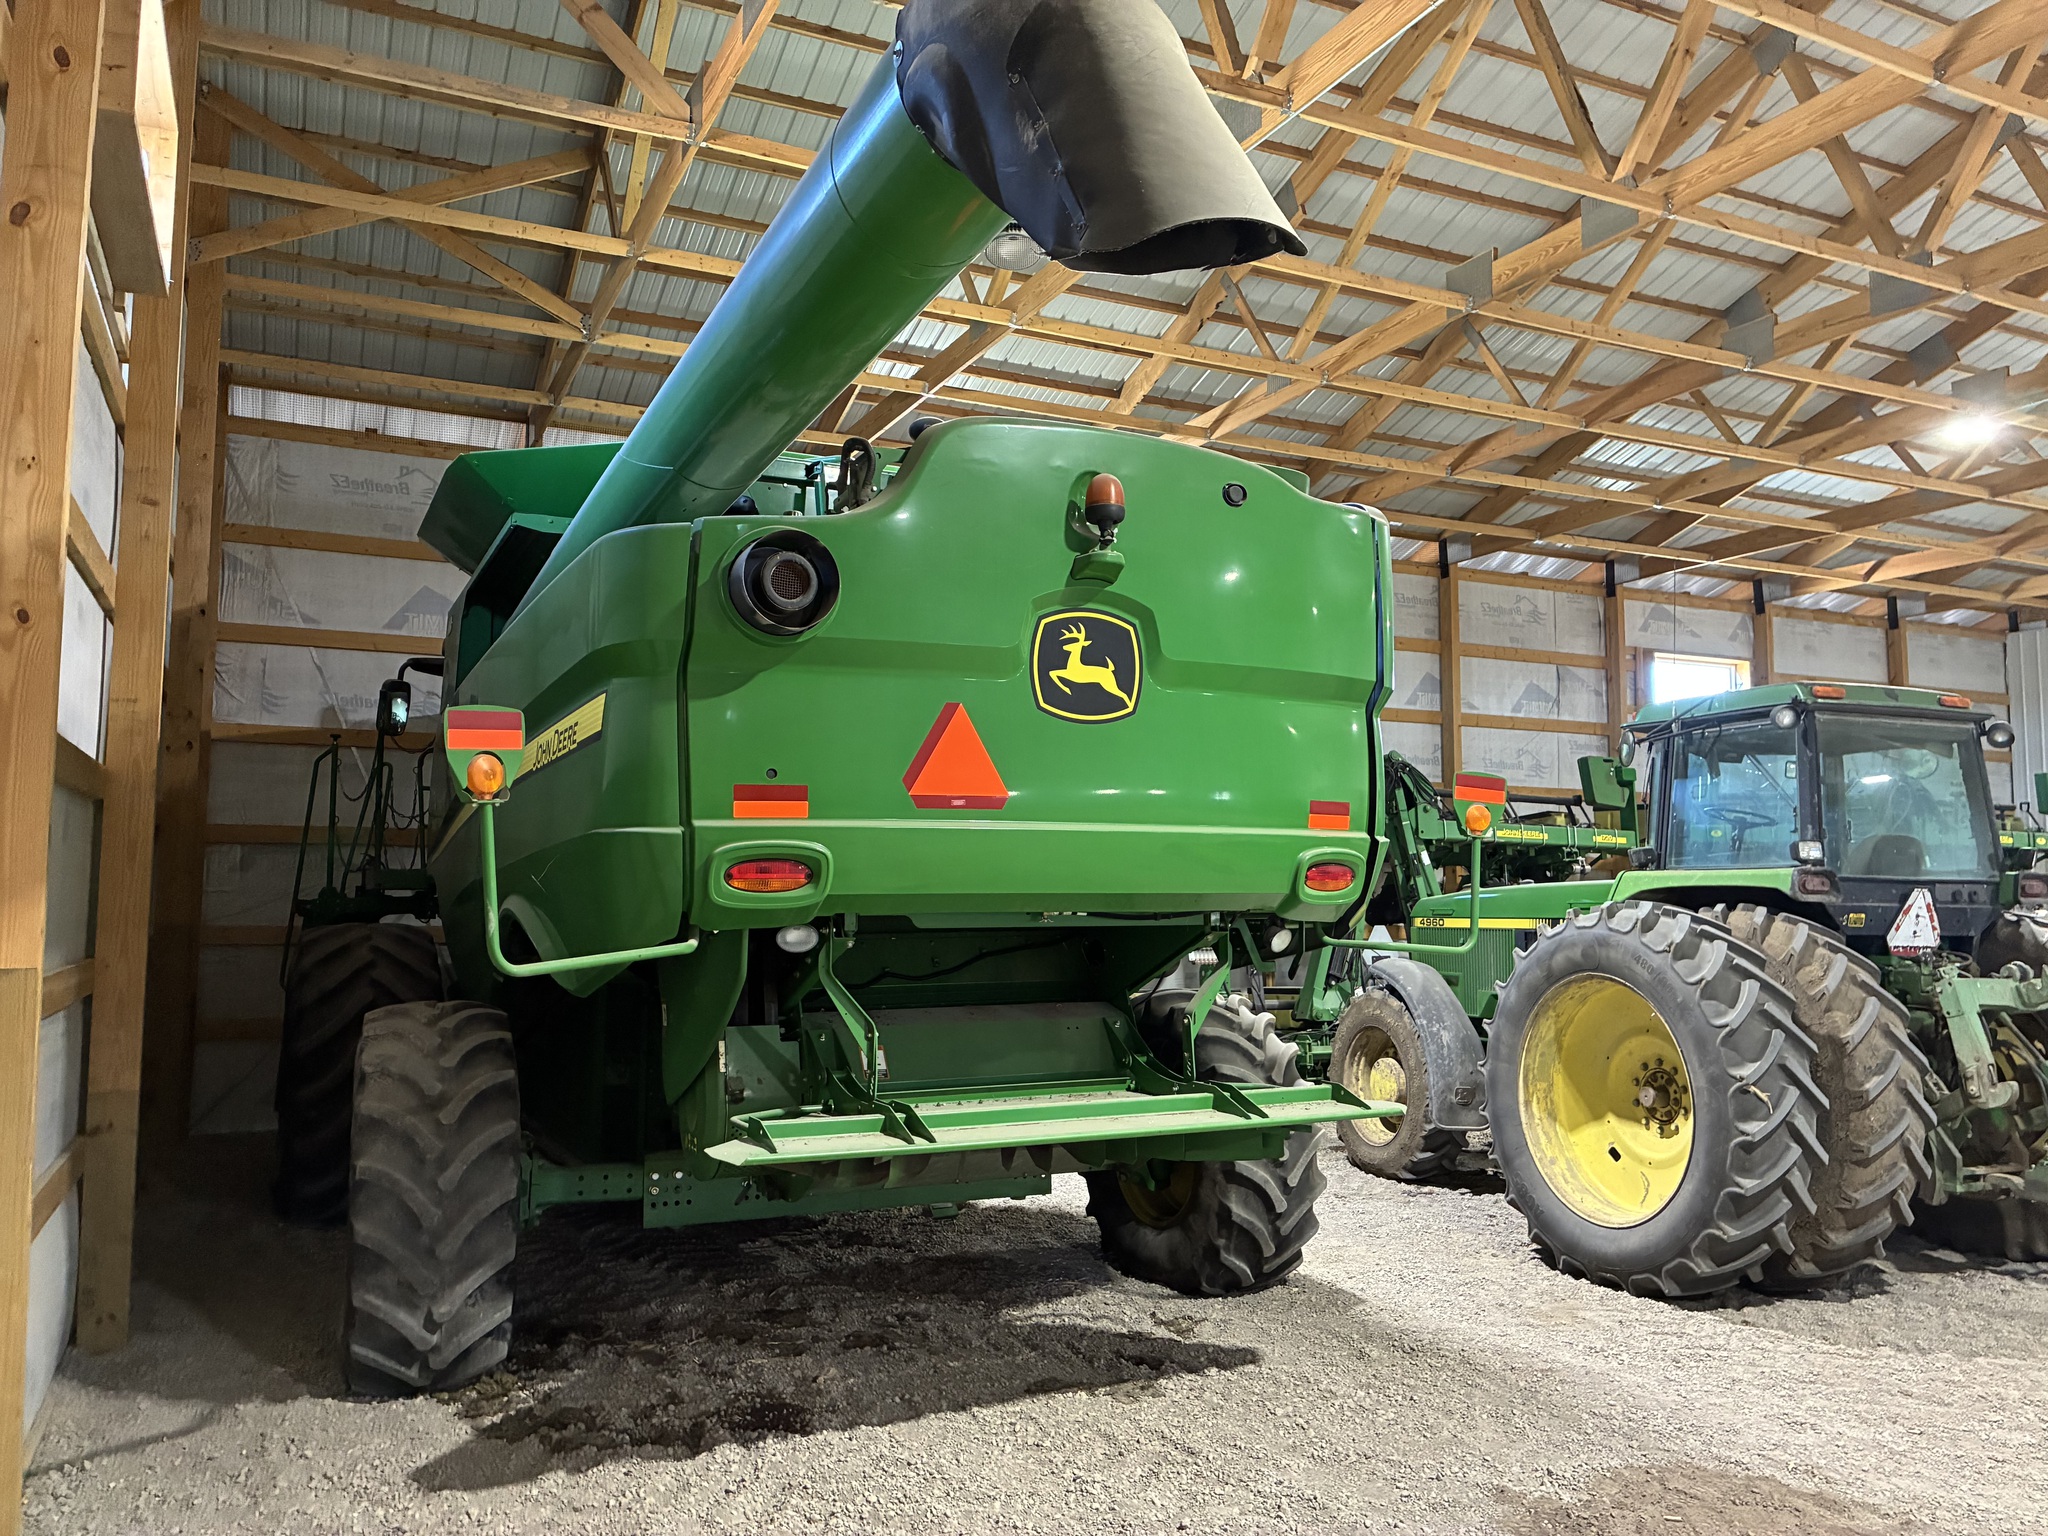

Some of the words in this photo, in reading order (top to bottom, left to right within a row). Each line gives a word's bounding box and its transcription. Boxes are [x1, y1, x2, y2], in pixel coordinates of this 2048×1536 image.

[532, 737, 553, 768] JOHN
[551, 721, 579, 757] DEERE
[1419, 918, 1445, 927] 4960
